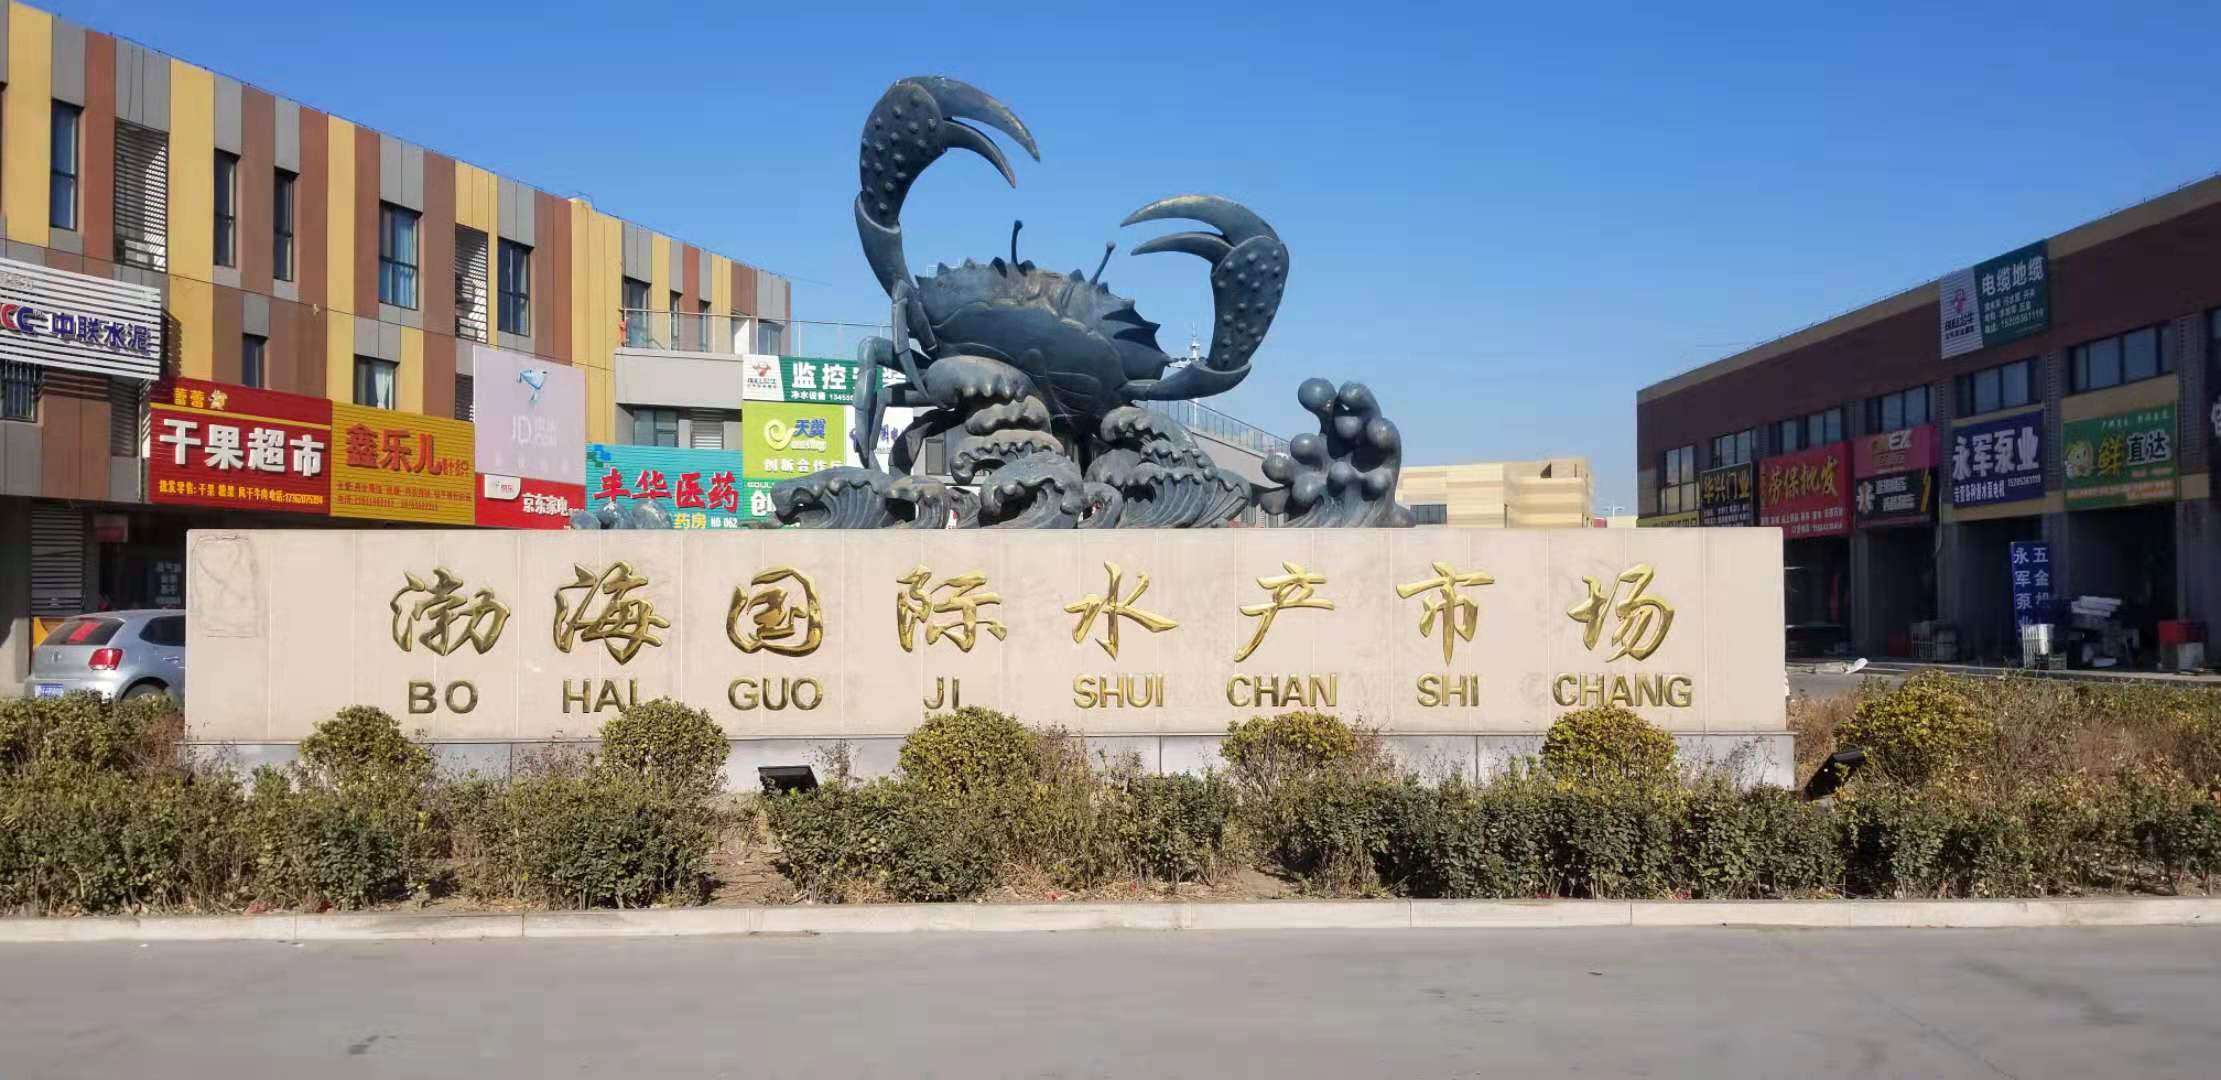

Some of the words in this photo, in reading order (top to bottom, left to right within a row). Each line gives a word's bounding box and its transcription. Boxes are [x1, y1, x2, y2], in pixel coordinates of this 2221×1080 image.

[1981, 255, 2045, 296] 电缆地缆
[52, 313, 149, 354] 中联水泥
[159, 418, 325, 477] 干果超市
[794, 418, 826, 438] 天翼
[1952, 426, 2040, 481] 永军泵业
[594, 467, 740, 514] 丰华医药
[390, 561, 1675, 664] 渤海国际水产市场
[408, 680, 478, 713] BO
[562, 679, 639, 713] HAI
[728, 679, 823, 712] GUO
[923, 676, 959, 710] JI
[1073, 673, 1164, 709] SHUI
[1226, 673, 1337, 708] CHAN
[1416, 673, 1479, 707] SHI
[1552, 672, 1692, 708] CHANG
